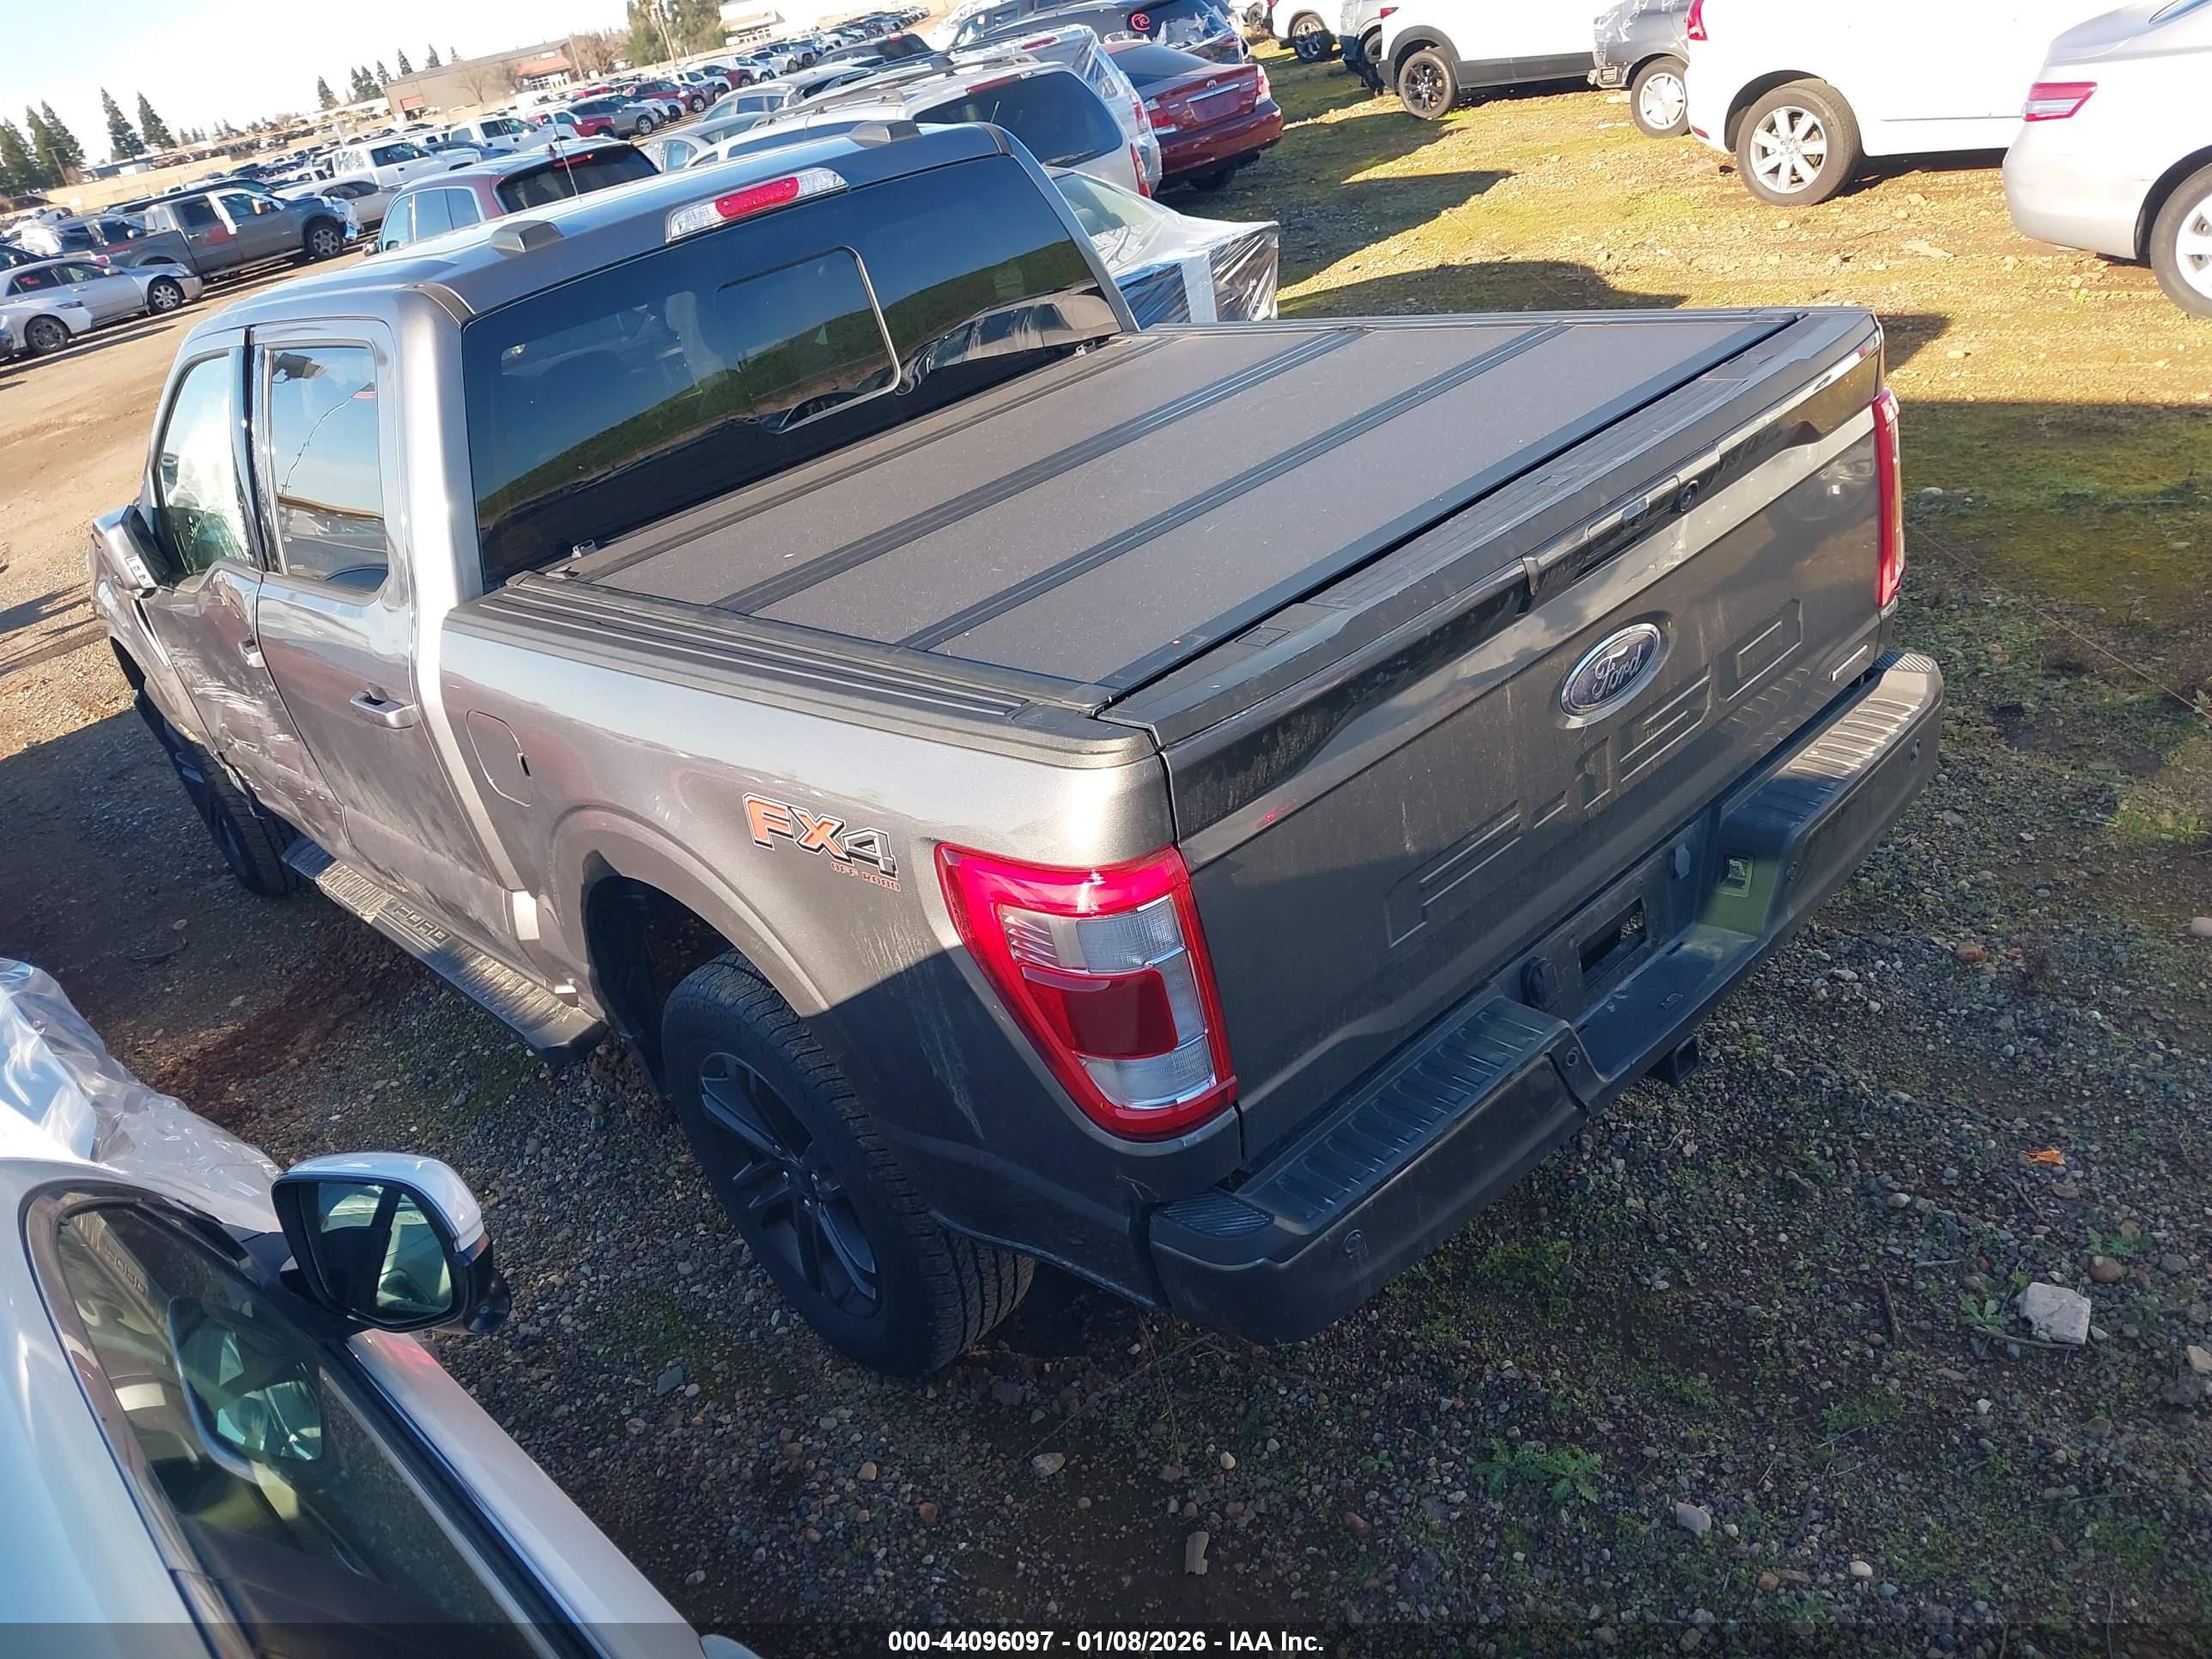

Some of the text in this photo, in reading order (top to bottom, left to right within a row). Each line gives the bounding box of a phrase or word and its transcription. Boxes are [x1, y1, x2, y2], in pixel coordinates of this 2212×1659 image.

[1591, 643, 1643, 701] Ford
[742, 793, 900, 880] FX4
[830, 861, 901, 892] OFF ROAD
[393, 904, 453, 947] FORD
